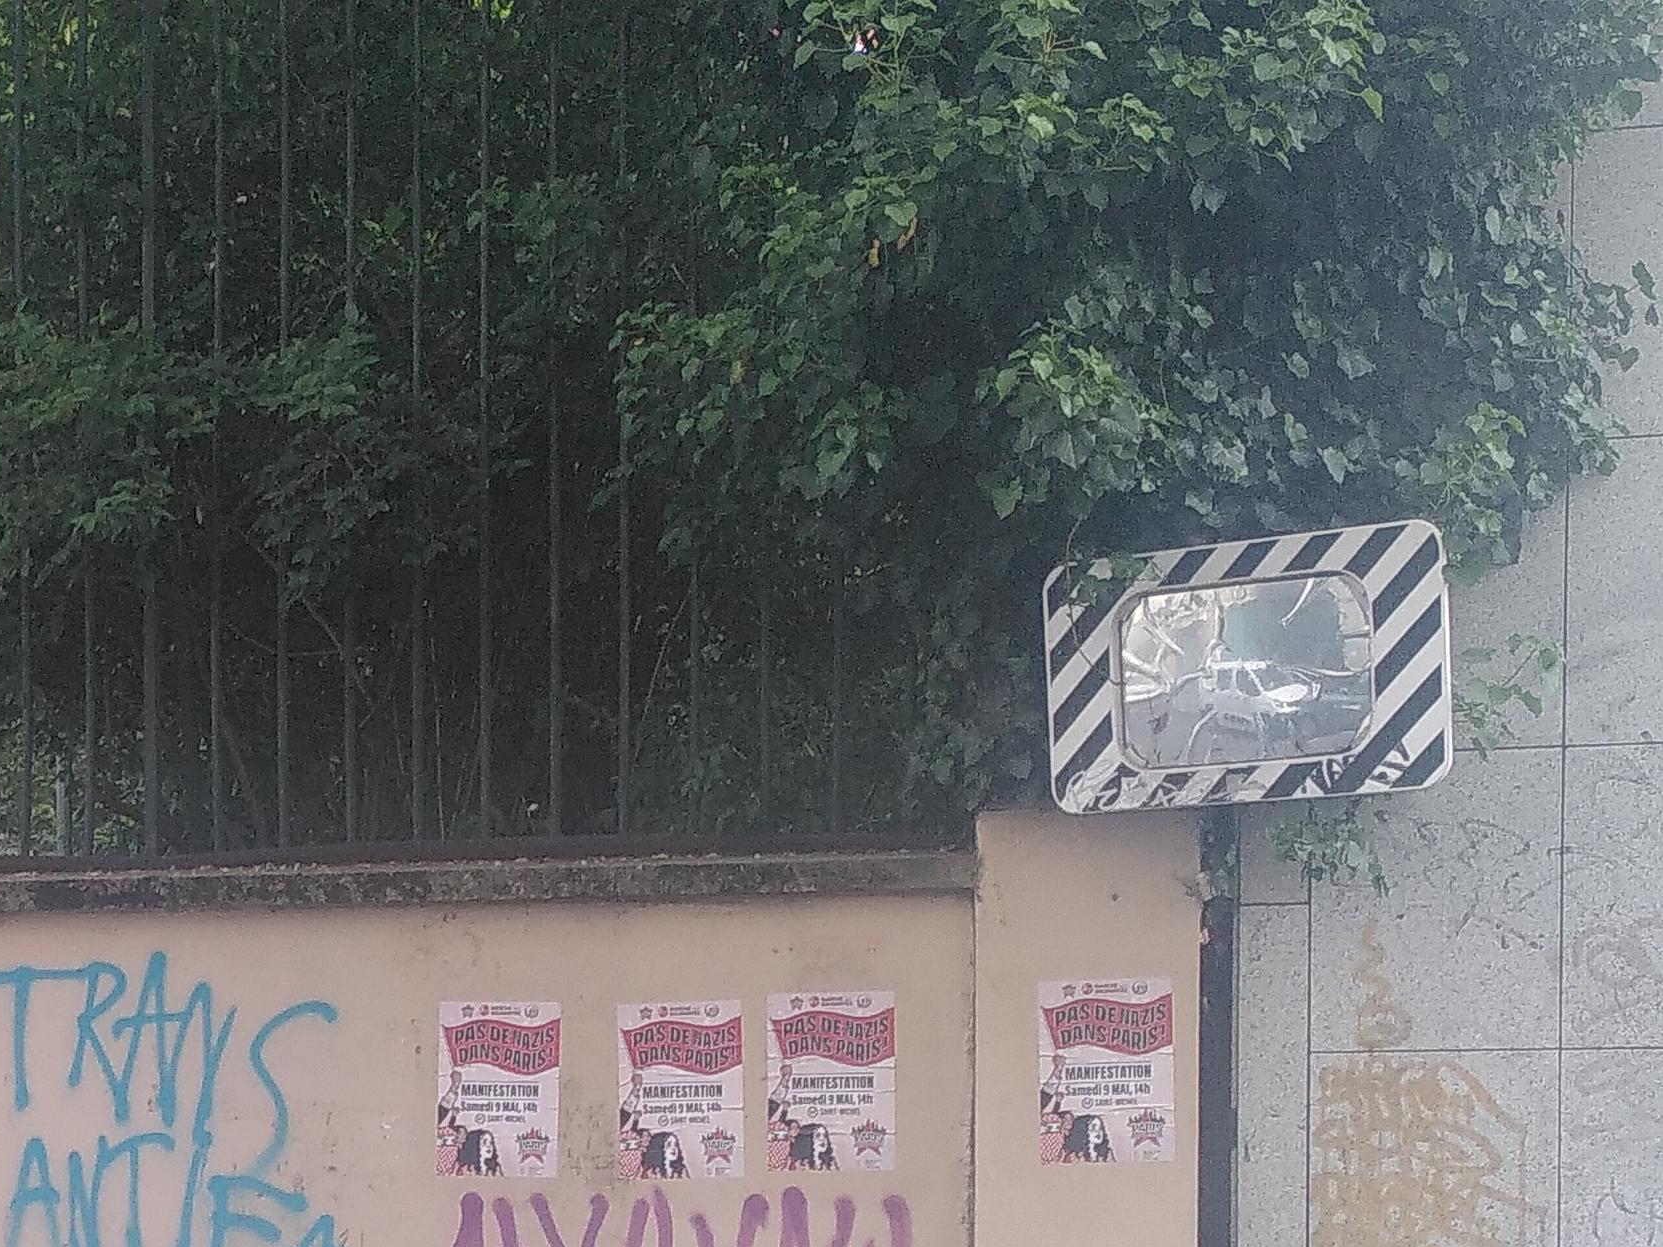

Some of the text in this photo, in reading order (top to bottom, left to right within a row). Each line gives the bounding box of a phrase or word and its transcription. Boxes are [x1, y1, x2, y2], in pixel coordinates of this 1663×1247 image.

[1055, 1003, 1166, 1027] PAS DE NAZIS
[632, 1024, 736, 1047] PAS DE NAZIS
[782, 1016, 889, 1038] PAS DE NAZIS
[1060, 1024, 1107, 1046] DANS
[454, 1023, 555, 1049] PAS DE NAZIS
[458, 1044, 500, 1063] DANS
[788, 1036, 833, 1056] DANS
[638, 1045, 680, 1066] DANS
[1065, 1064, 1152, 1080] MANIFESTATION
[461, 1084, 539, 1097] MANIFESTATION
[642, 1084, 723, 1099] MANIFESTATION
[792, 1076, 874, 1090] MANIFESTATION
[1064, 1083, 1102, 1096] Samedi
[460, 1101, 494, 1112] Samedi
[642, 1103, 677, 1114] Samedi
[791, 1094, 827, 1106] Samedi
